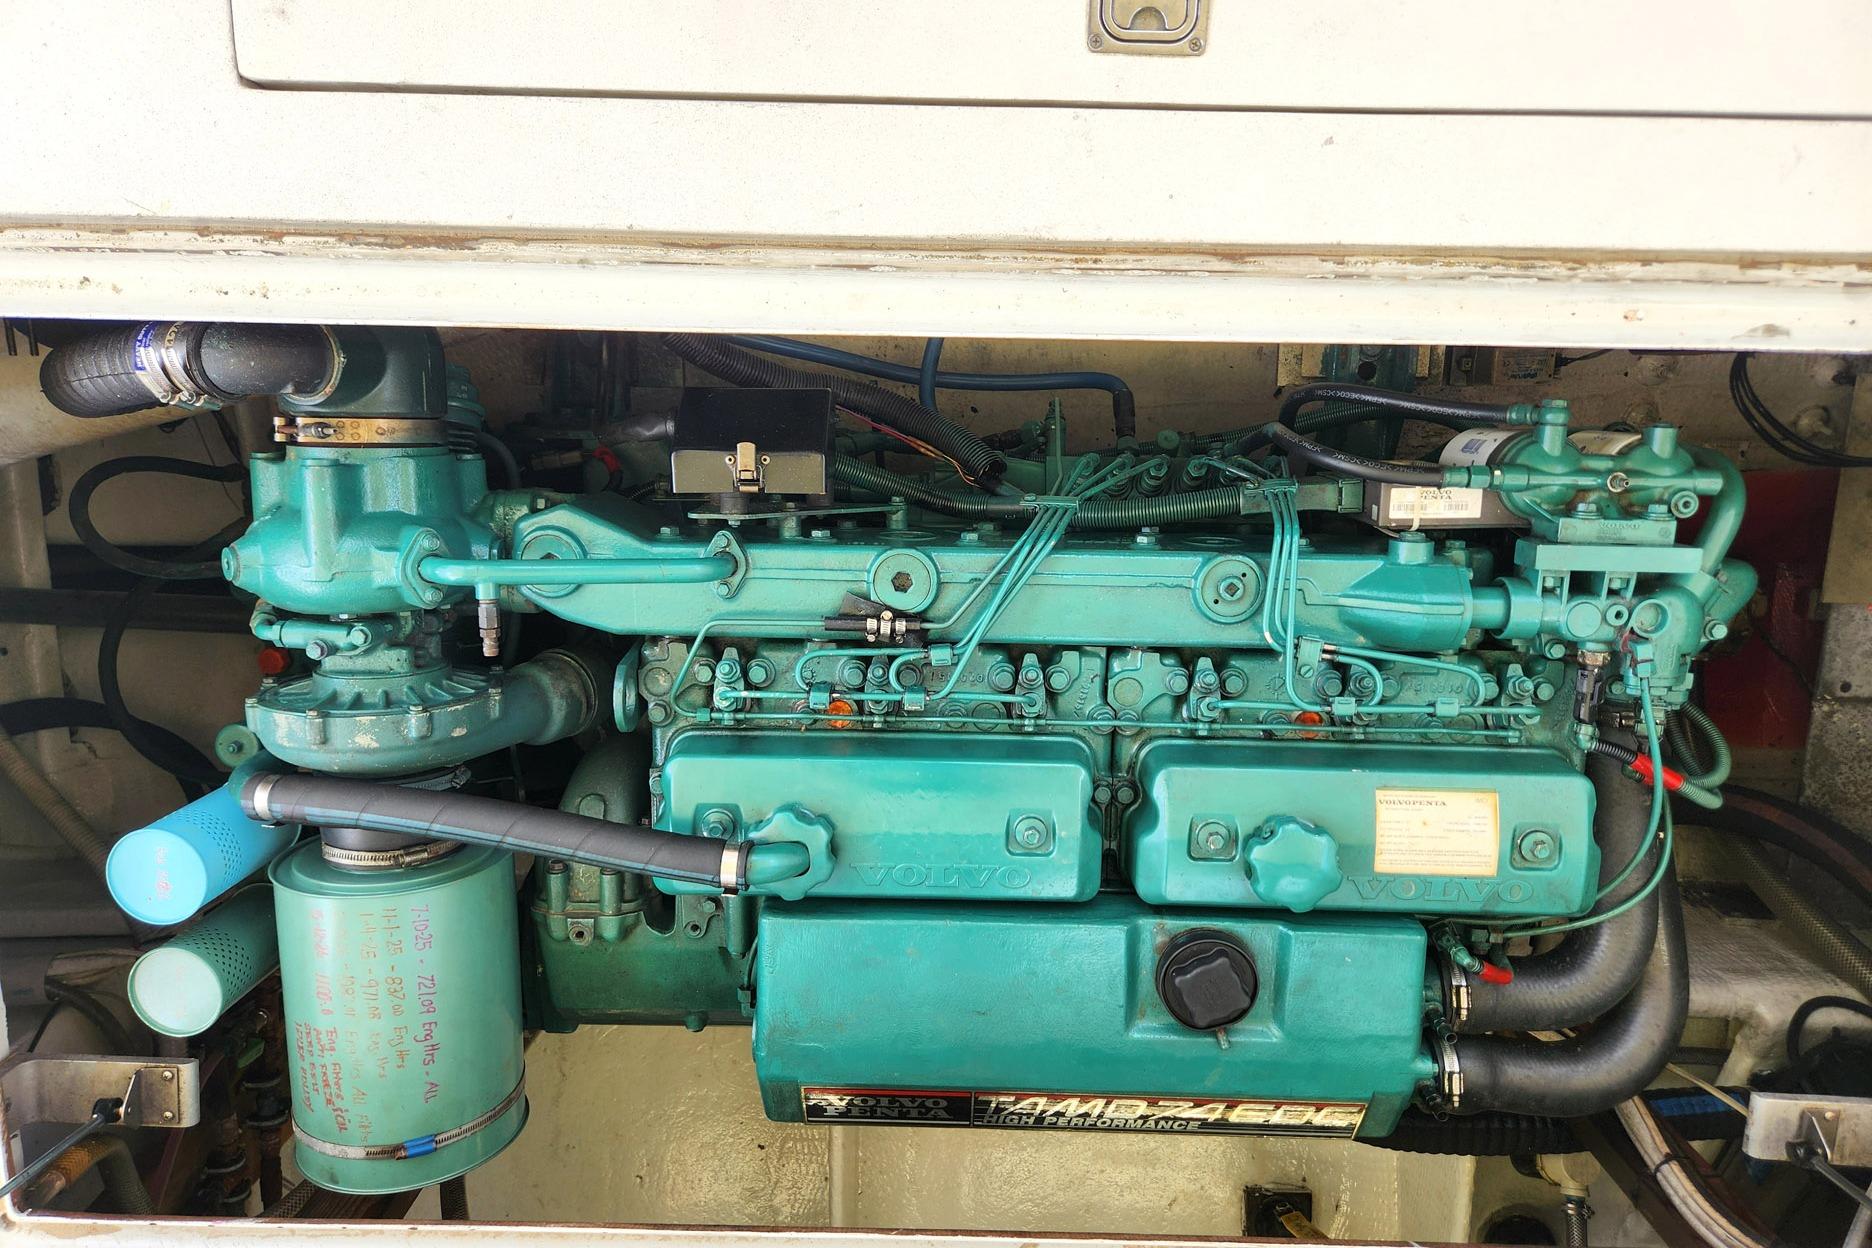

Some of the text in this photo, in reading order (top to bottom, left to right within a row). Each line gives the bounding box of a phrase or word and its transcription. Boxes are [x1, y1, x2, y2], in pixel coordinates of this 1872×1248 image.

[850, 863, 1031, 889] VOLVO
[1347, 876, 1534, 903] VOLVO
[830, 1095, 949, 1109] VOLVO
[823, 1106, 953, 1119] PENTA
[982, 1114, 1201, 1131] HIGH PERFORMANCE
